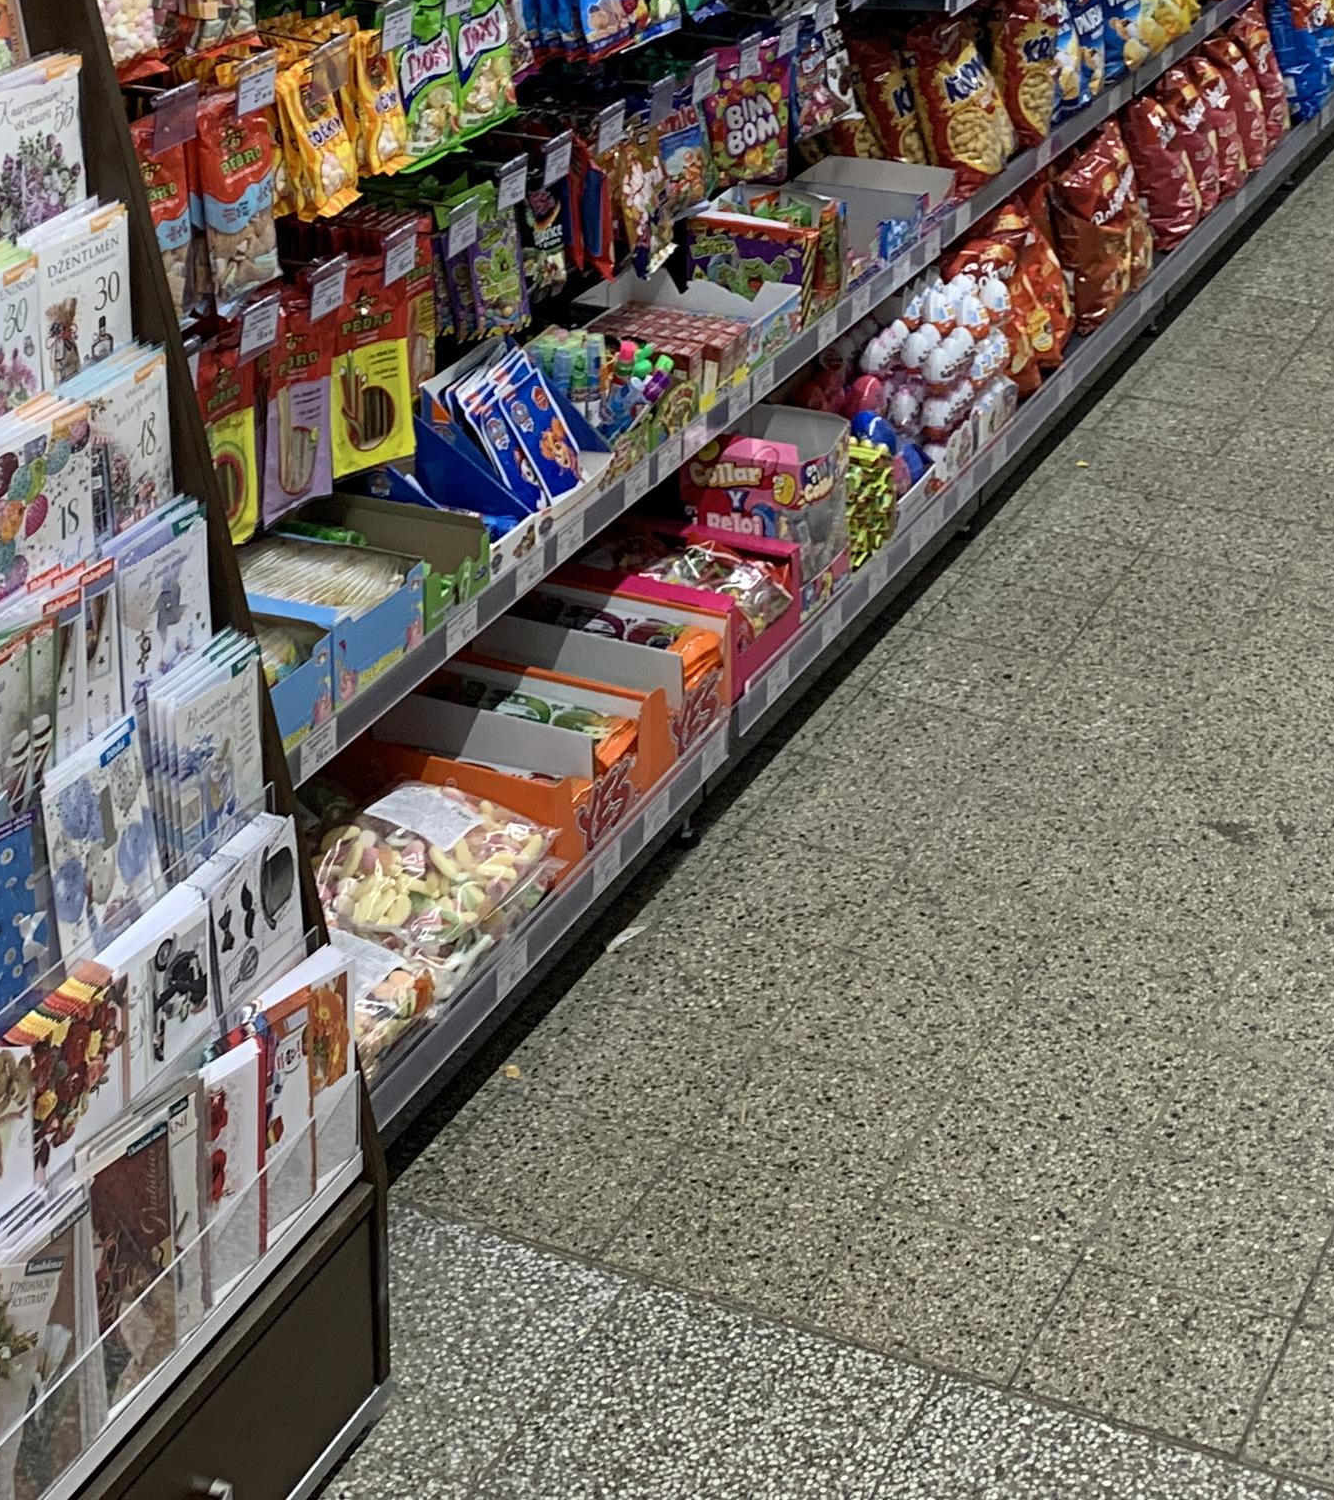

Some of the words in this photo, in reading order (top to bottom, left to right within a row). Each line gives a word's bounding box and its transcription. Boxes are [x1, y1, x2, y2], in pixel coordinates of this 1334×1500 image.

[725, 91, 773, 131] BIM
[726, 114, 781, 157] BOM
[219, 143, 263, 172] PEDRO
[46, 236, 120, 279] DŽENTLMEN
[93, 270, 121, 313] 30
[2, 297, 29, 343] 30
[341, 310, 393, 335] PEDRO
[688, 461, 762, 487] Collar
[57, 497, 80, 542] 18
[726, 489, 750, 510] Y
